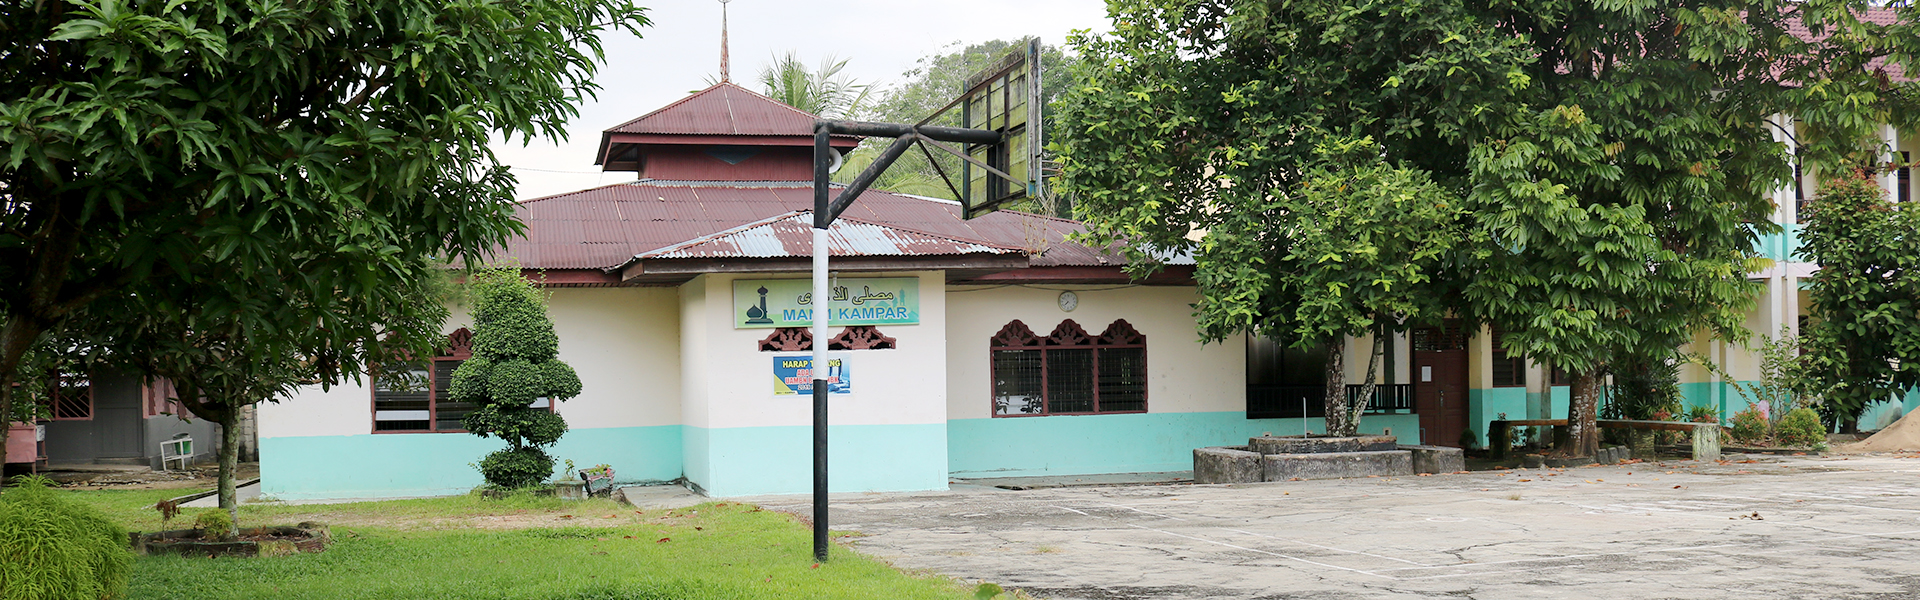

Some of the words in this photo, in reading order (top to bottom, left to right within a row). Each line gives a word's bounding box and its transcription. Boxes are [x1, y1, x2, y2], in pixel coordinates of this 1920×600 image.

[839, 306, 908, 320] KAMPAR
[782, 360, 809, 368] HARAP
[796, 369, 810, 377] ADA
